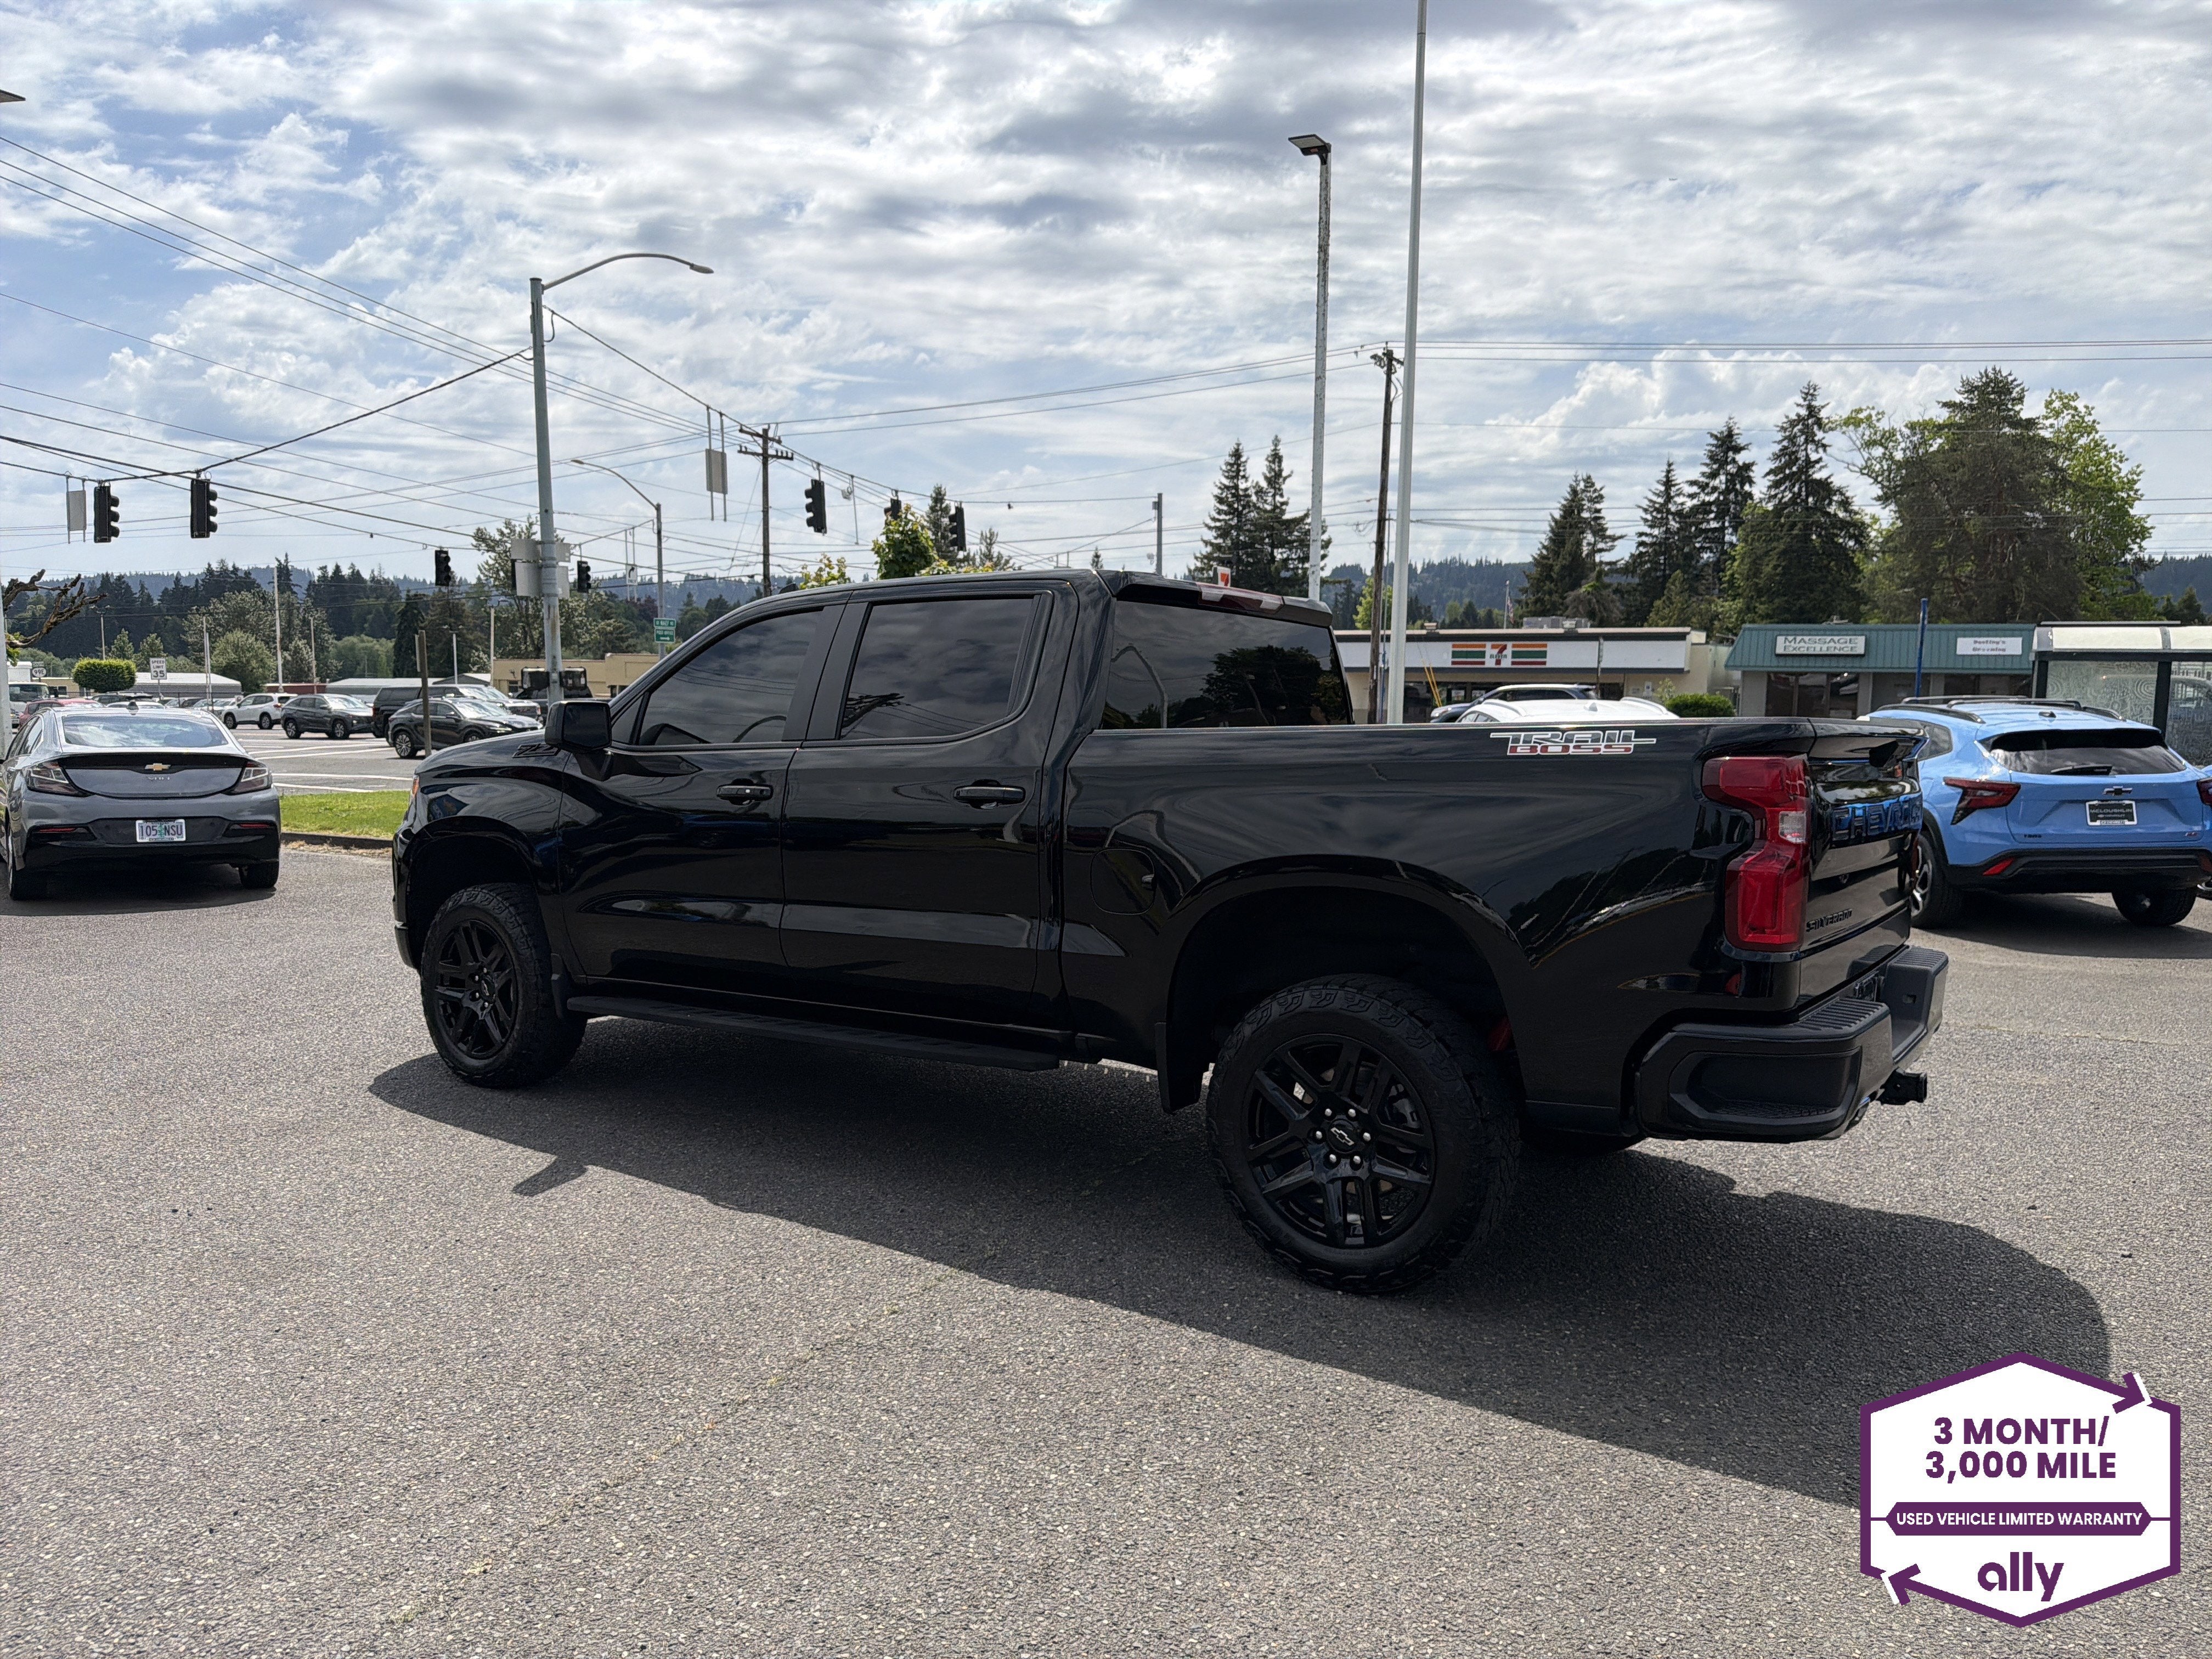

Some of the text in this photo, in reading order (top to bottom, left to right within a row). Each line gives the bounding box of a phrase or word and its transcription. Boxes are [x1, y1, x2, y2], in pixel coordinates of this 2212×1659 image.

[1490, 730, 1656, 744] TRAIL
[1507, 743, 1634, 755] BOSS
[140, 825, 183, 837] 105 NSU
[1806, 909, 1853, 932] SILVERADO
